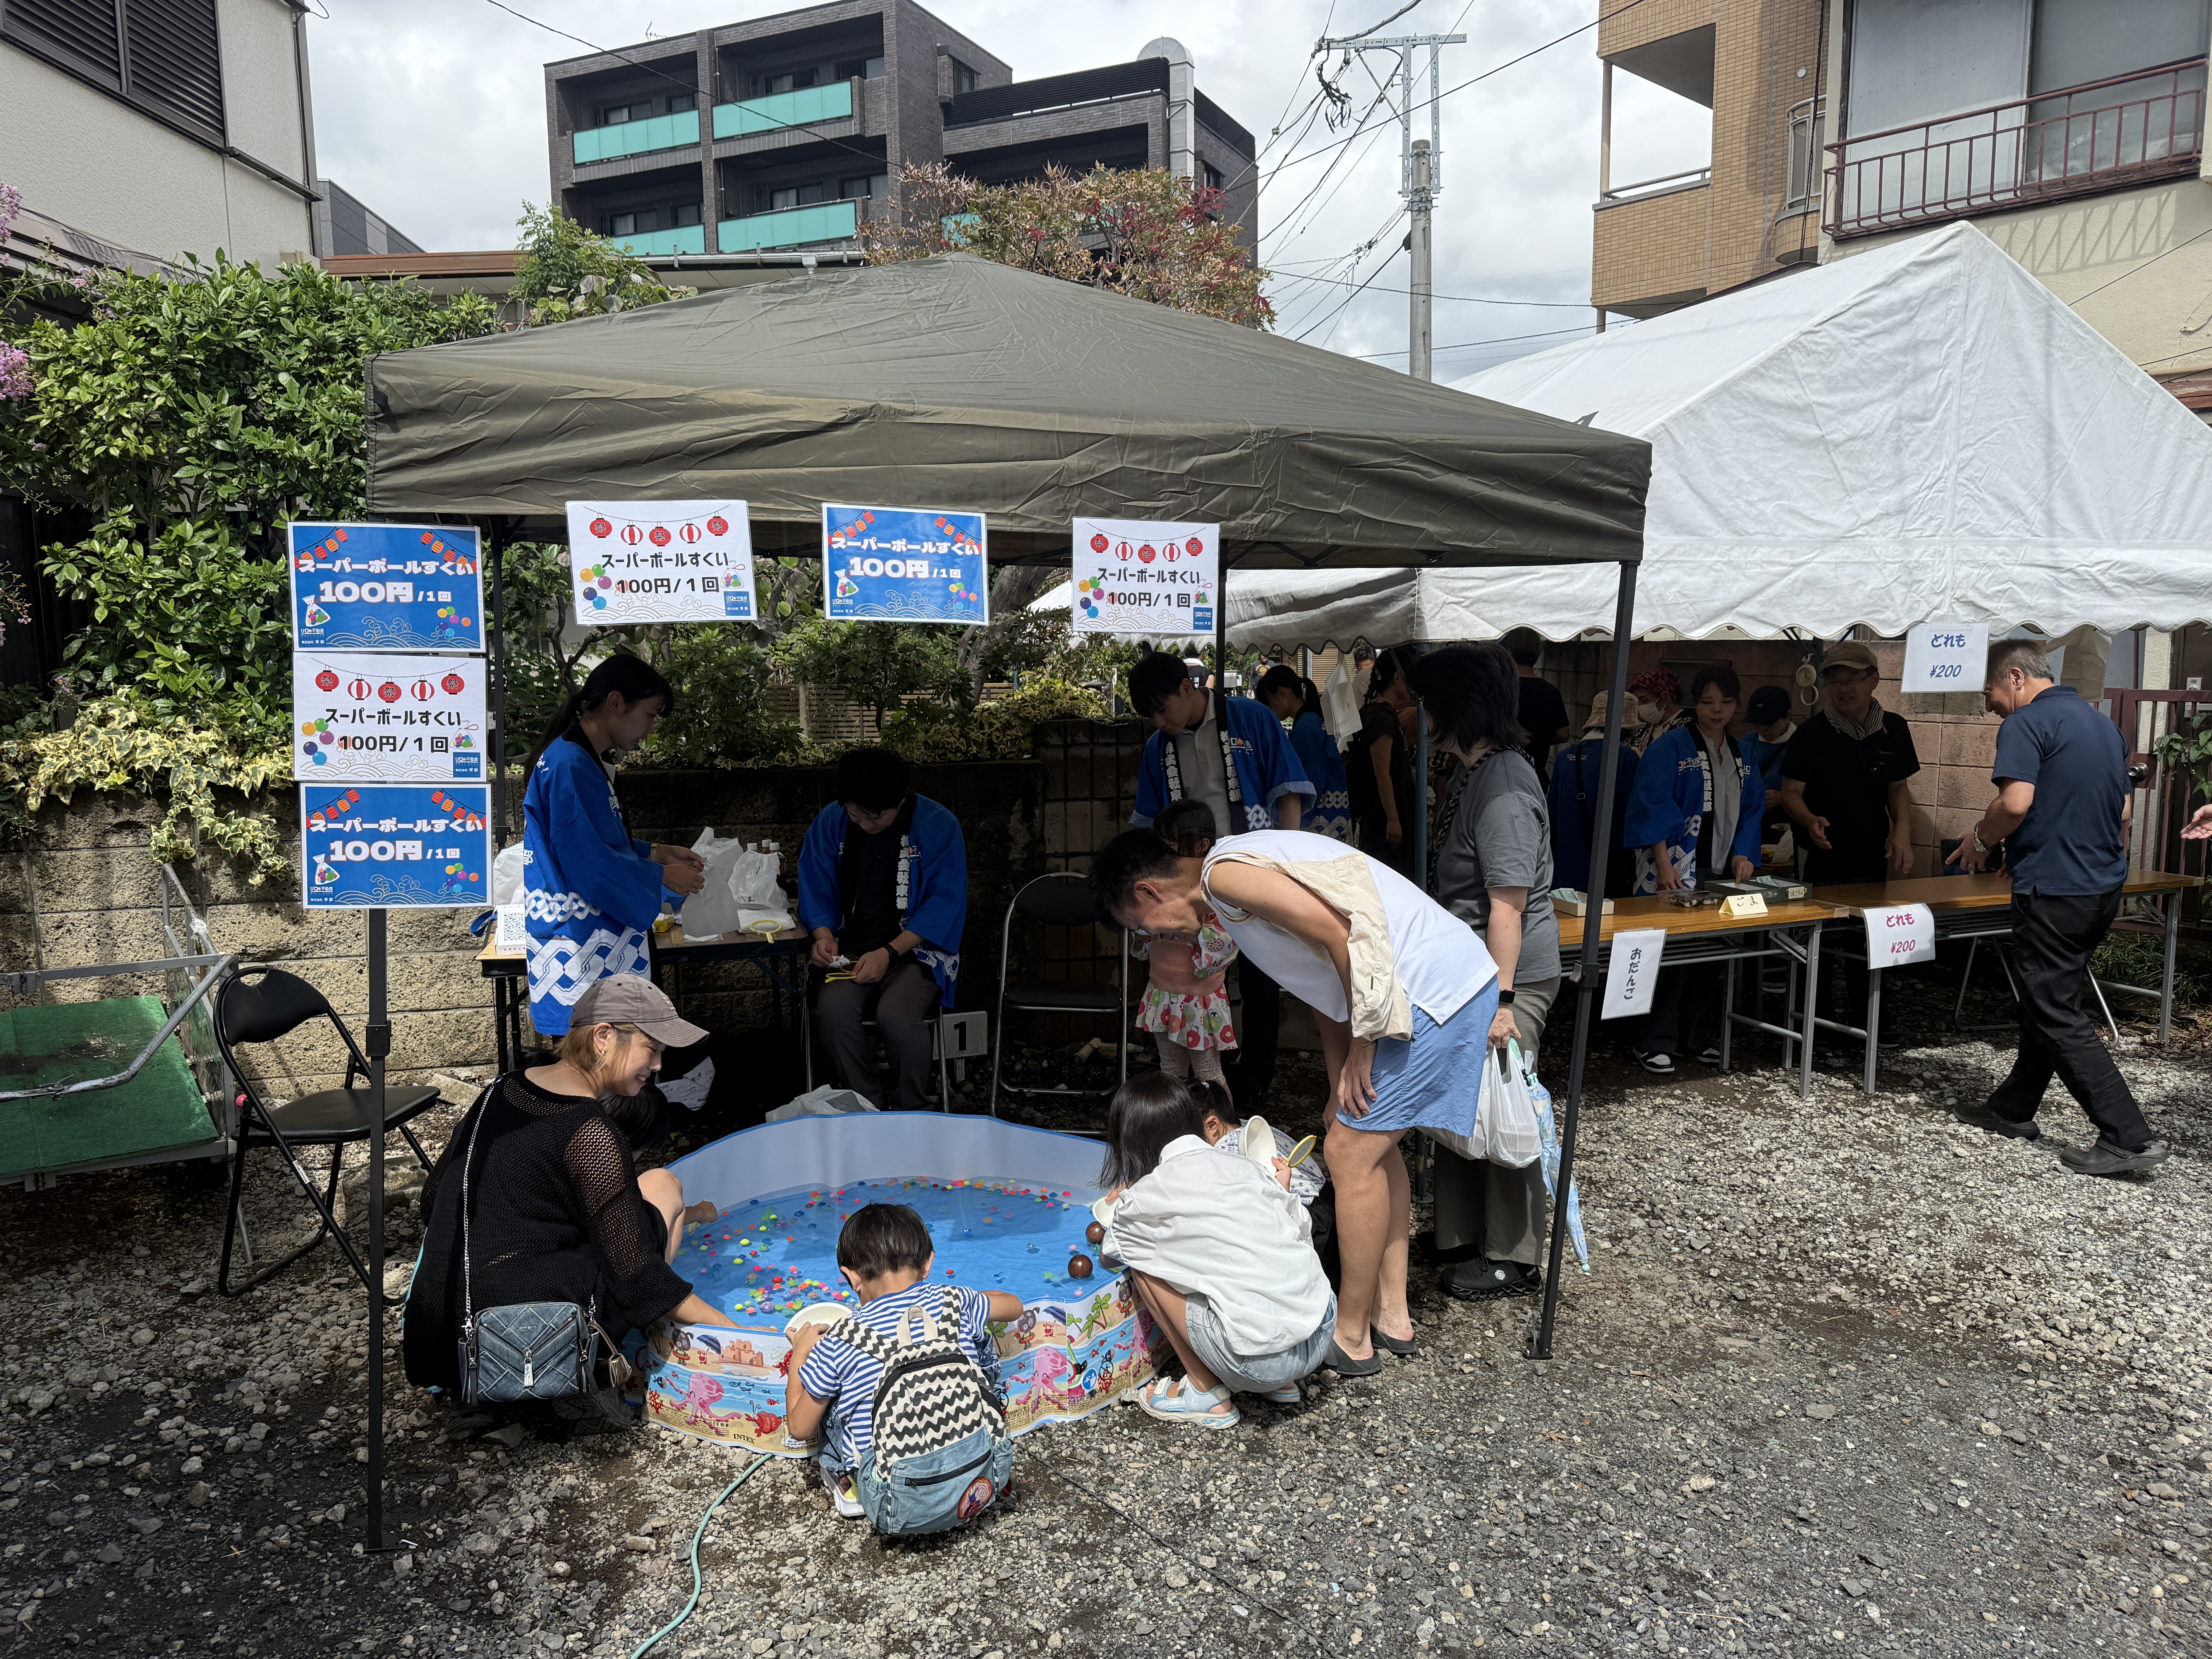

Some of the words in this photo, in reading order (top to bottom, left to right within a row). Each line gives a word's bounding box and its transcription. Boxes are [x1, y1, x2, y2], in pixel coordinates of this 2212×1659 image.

[831, 537, 980, 555] スーパーボールすくい
[298, 557, 474, 575] スーパーボールすくい
[601, 552, 728, 568] スーパーボールすくい
[1097, 567, 1199, 584] スーパーボールすくい
[1931, 634, 1966, 648] どれも
[1930, 665, 1962, 678] ¥200
[325, 708, 461, 726] スーパーボールすくい
[310, 817, 483, 833] スーパーボールすくい
[1891, 939, 1915, 953] ¥200
[1624, 948, 1642, 1000] おだんご
[954, 1021, 966, 1051] 1
[733, 1434, 754, 1444] INTEX
